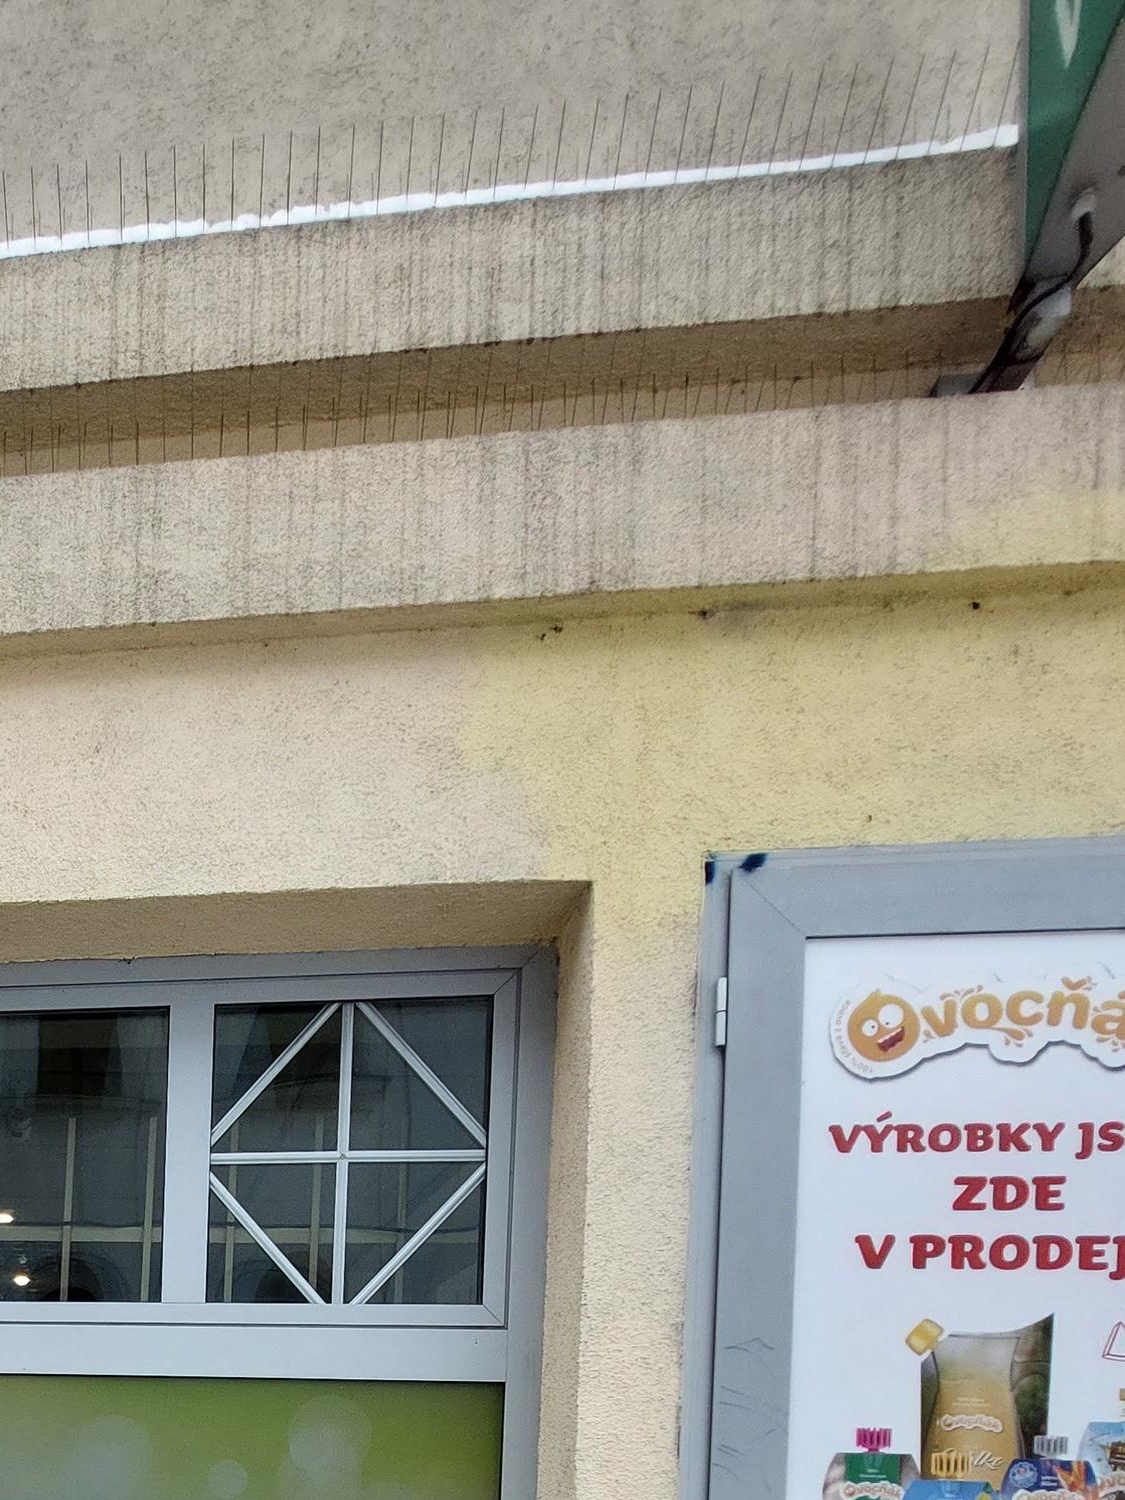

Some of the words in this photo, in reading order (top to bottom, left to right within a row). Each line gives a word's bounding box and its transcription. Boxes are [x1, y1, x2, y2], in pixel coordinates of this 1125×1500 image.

[828, 1111, 1066, 1154] VÝROBKY
[1076, 1121, 1125, 1160] JS
[952, 1175, 1067, 1212] ZDE
[855, 1234, 896, 1270] V
